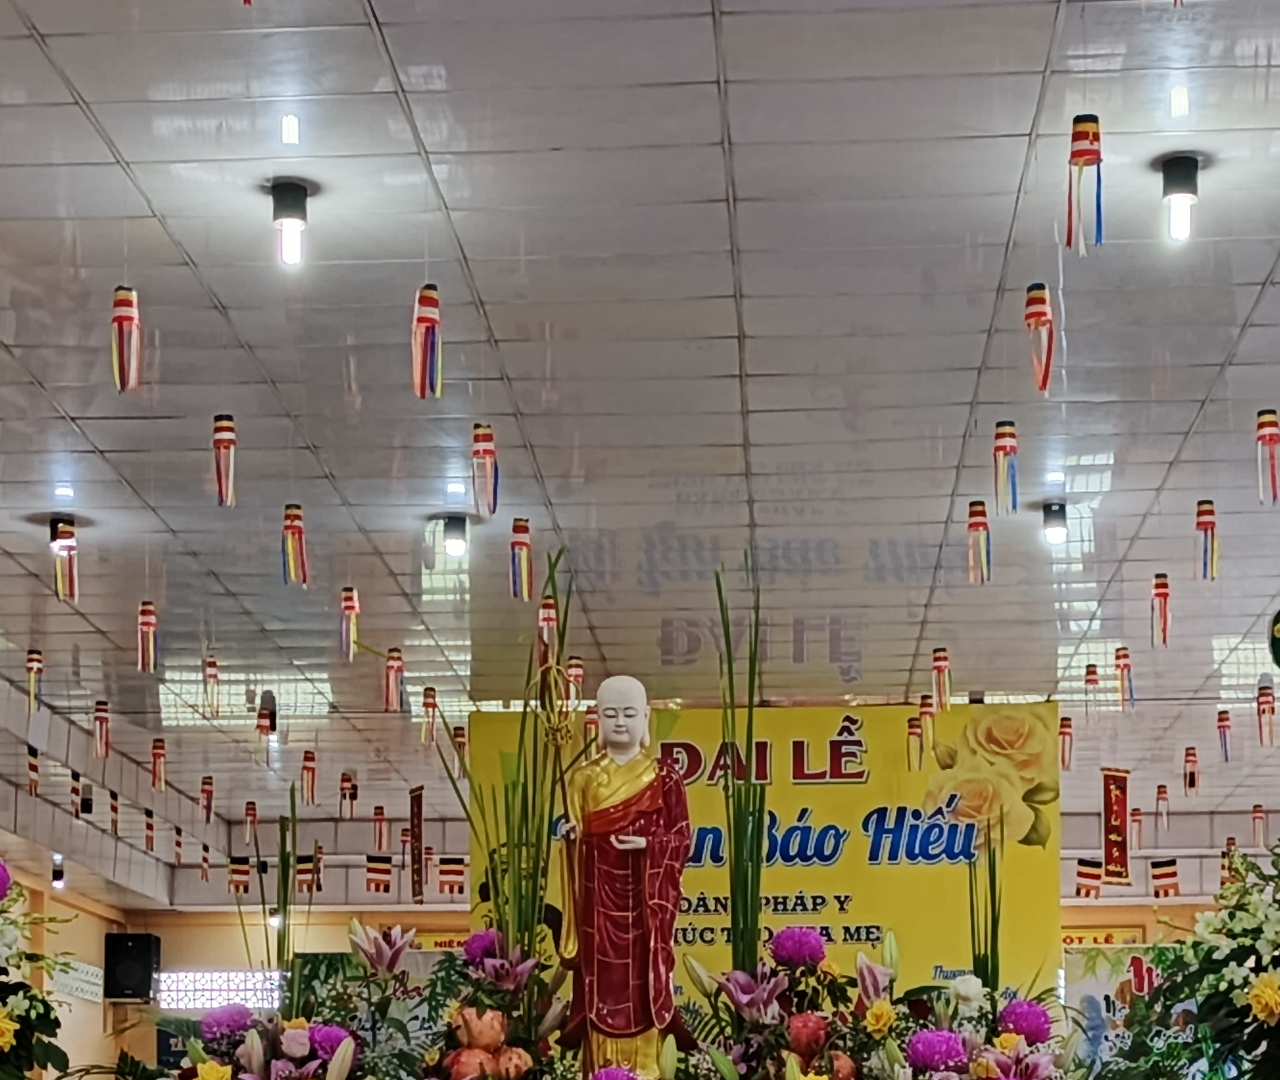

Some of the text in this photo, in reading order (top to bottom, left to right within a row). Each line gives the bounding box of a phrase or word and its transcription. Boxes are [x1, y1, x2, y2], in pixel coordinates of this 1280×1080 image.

[792, 714, 868, 782] LỄ
[862, 793, 977, 864] Hiếu
[679, 891, 730, 914] DÂN
[833, 894, 851, 913] Y
[842, 925, 882, 949] MẸ
